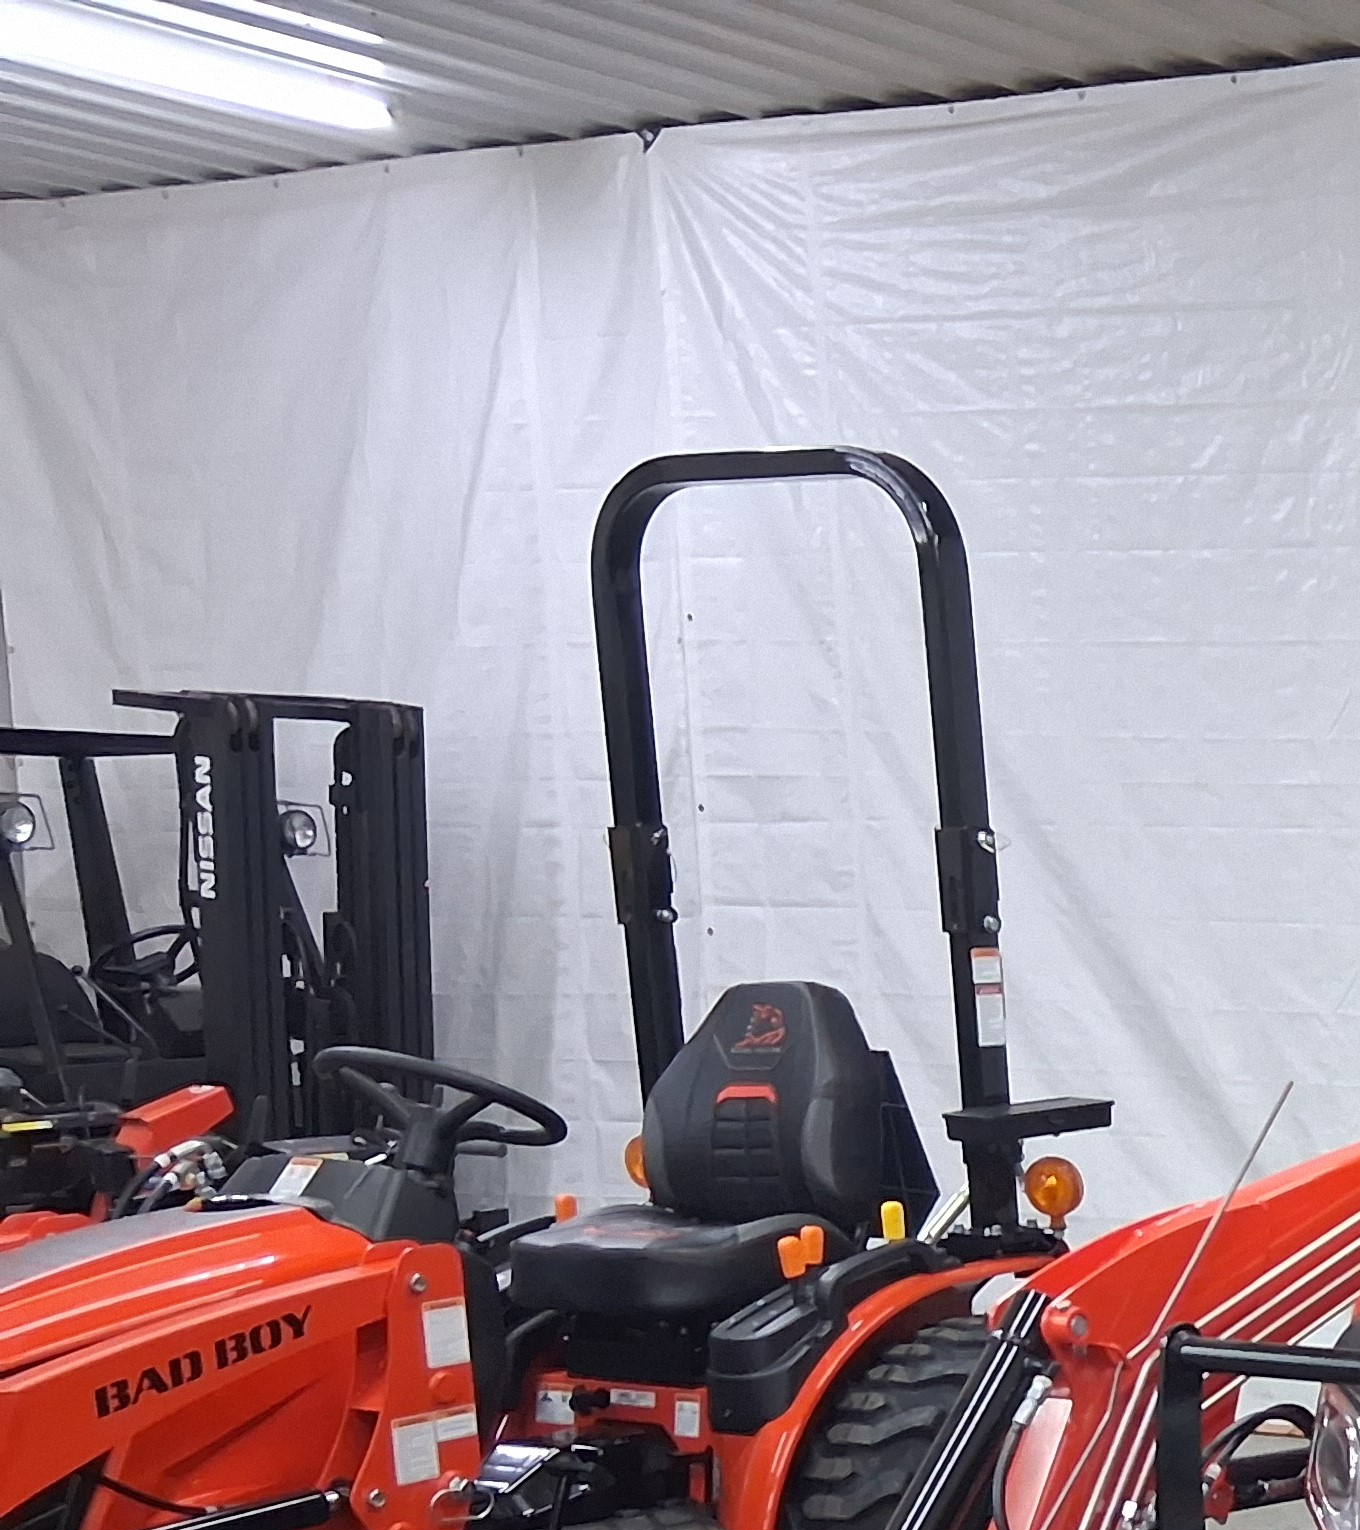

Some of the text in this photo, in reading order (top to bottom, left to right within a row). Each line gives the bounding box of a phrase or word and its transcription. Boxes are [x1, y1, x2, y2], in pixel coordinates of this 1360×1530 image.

[194, 755, 216, 899] NISSAN
[95, 1305, 311, 1418] BAD BOY
